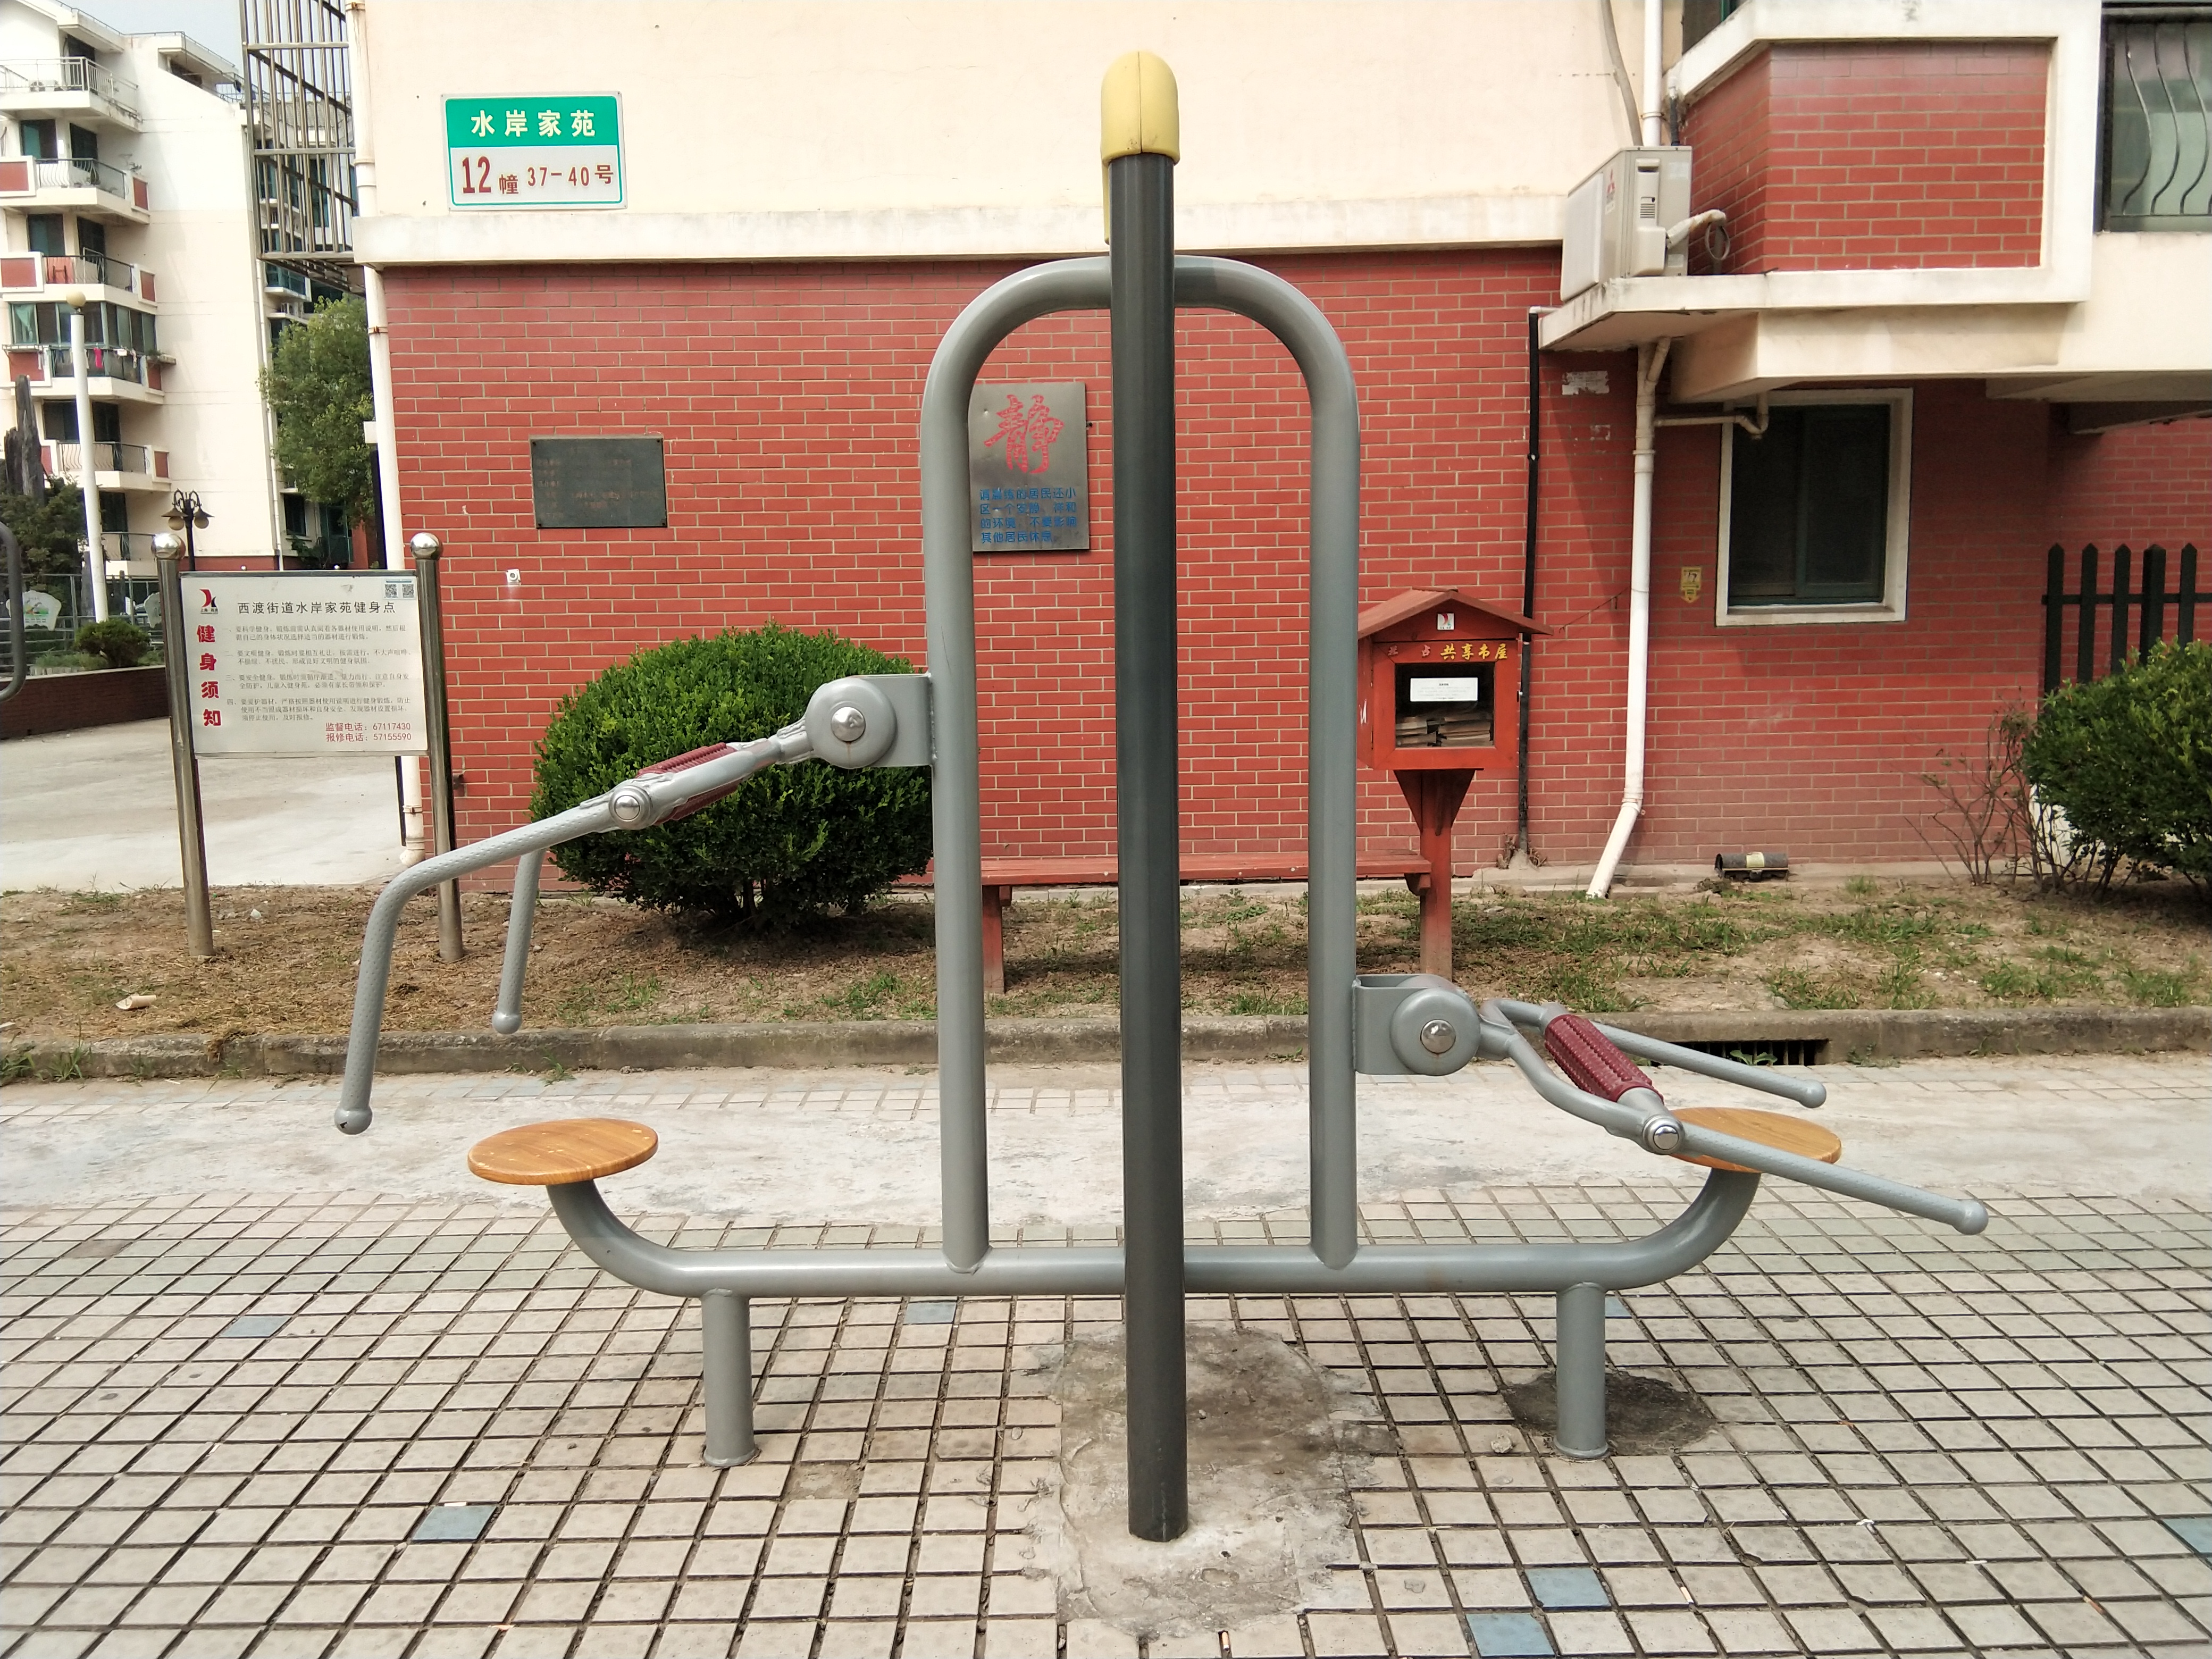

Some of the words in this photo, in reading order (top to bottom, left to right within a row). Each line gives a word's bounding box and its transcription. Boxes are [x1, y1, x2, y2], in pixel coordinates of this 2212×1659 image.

[471, 109, 596, 137] 水岸家苑
[980, 487, 1076, 500] 请晨练的居民还小
[981, 531, 1052, 543] 其他居民休息
[237, 601, 396, 614] 西渡街道水岸家苑健身点
[197, 625, 222, 726] 健身须知
